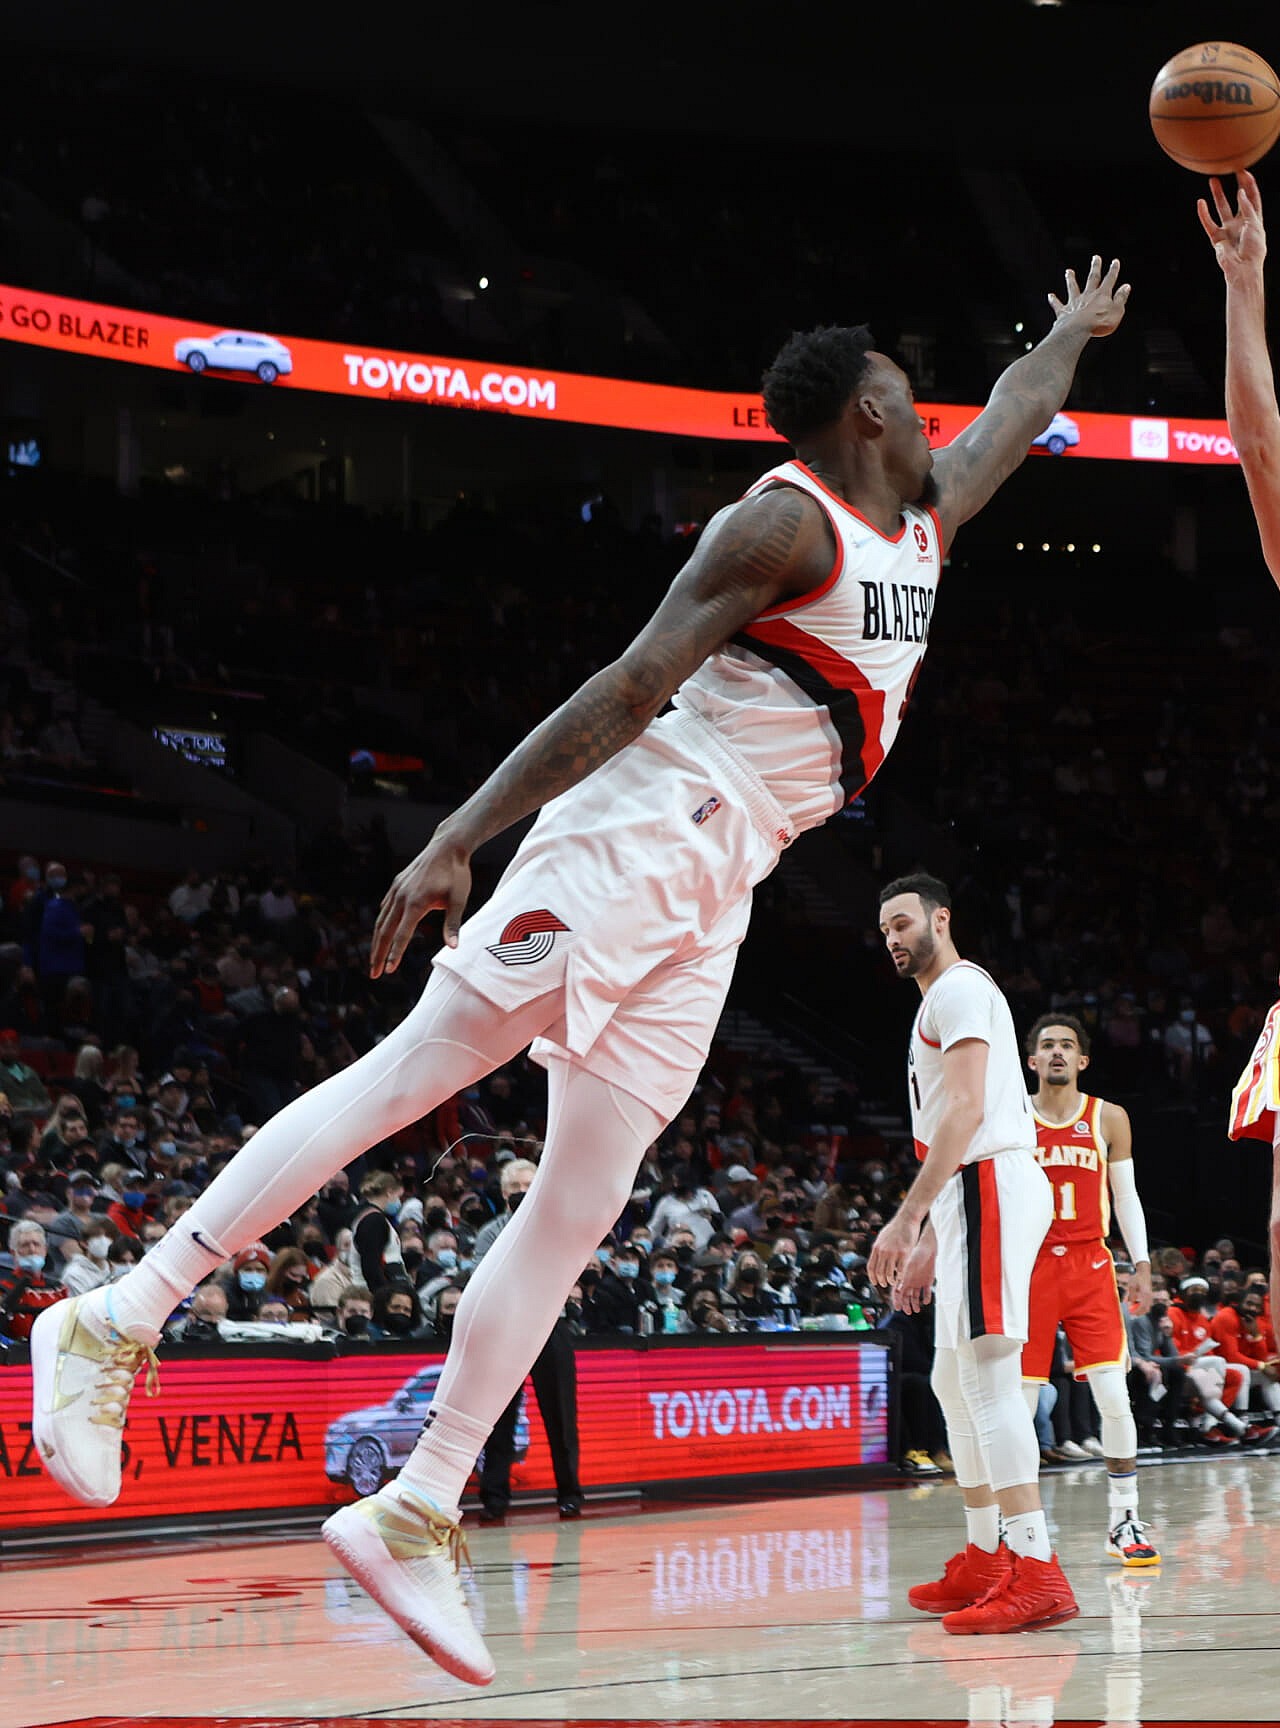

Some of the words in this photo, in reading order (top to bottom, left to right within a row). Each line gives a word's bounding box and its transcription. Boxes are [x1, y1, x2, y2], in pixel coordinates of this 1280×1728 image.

[1163, 79, 1254, 105] Wilson
[11, 305, 51, 331] GO
[59, 314, 149, 348] BLAZER
[343, 353, 556, 410] TOYOTA.COM
[1173, 431, 1238, 458] TOYO
[1034, 1145, 1098, 1172] LANTA
[648, 1383, 851, 1440] TOYOTA.COM
[158, 1412, 304, 1468] VENZA
